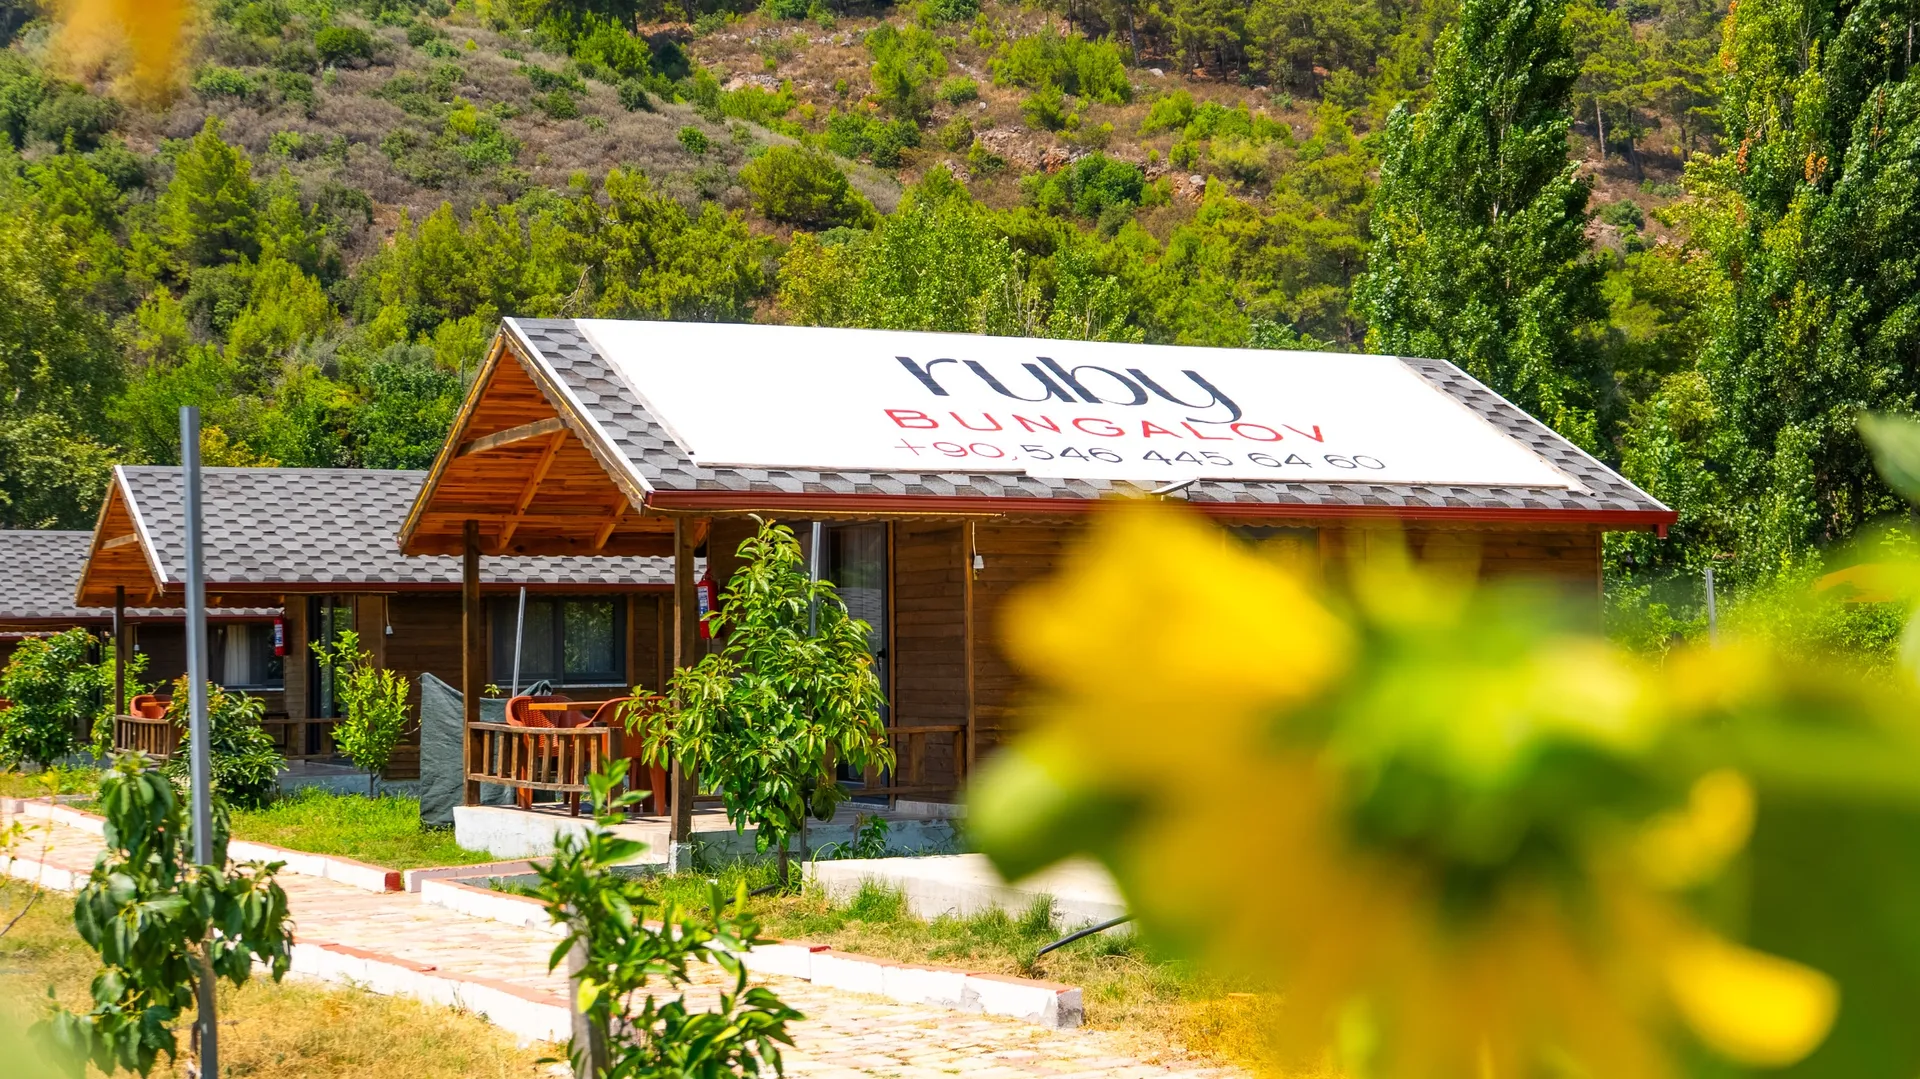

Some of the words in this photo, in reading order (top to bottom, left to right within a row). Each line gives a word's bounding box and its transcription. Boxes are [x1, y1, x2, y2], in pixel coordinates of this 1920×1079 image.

[894, 355, 1243, 424] ruby
[883, 408, 1325, 443] BUNGALOV
[1142, 450, 1234, 468] 445
[1247, 452, 1313, 469] 64
[1323, 454, 1387, 471] 60
